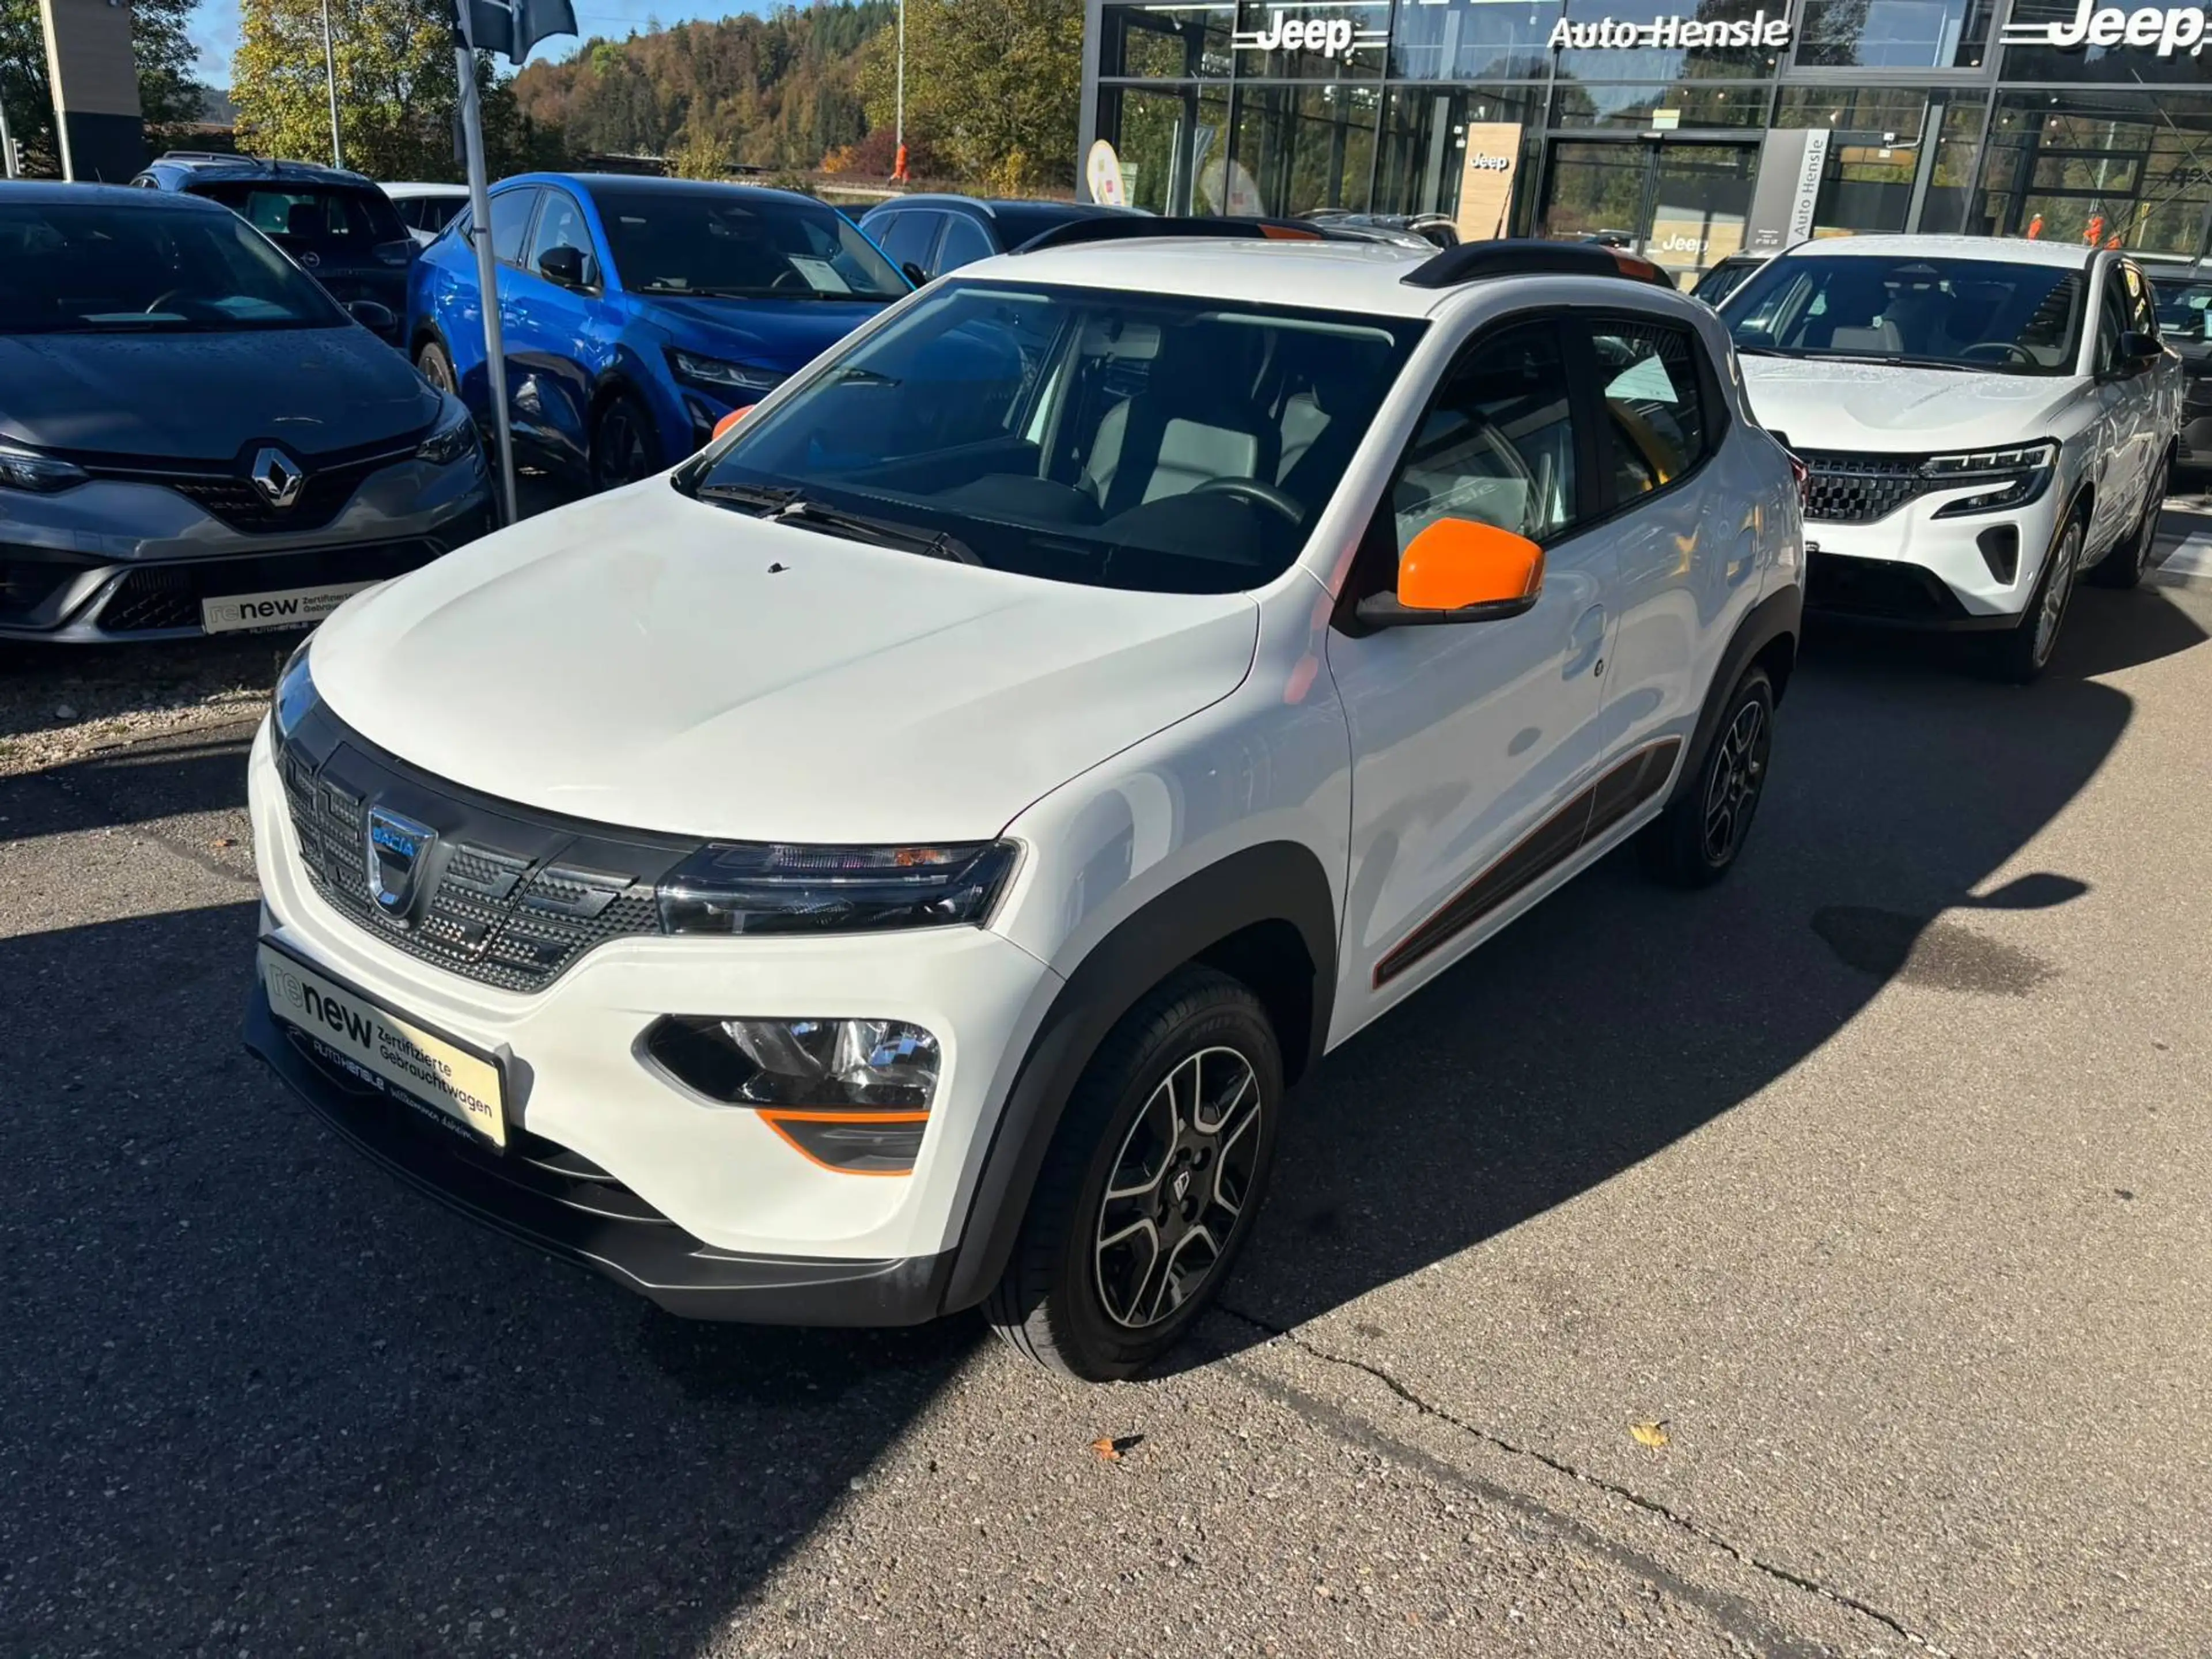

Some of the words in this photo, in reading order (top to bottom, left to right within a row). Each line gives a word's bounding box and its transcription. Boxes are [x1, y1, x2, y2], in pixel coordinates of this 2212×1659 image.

[1256, 10, 1352, 58] Jeep
[1546, 16, 1639, 48] Auto
[1651, 10, 1791, 48] Hensle
[2047, 0, 2205, 56] Jeep
[1470, 151, 1509, 172] Jeep
[1802, 139, 1824, 194] Hensle
[1794, 199, 1811, 237] Auto
[209, 599, 298, 623] renew
[372, 826, 414, 857] DACIA
[270, 964, 372, 1049] renew
[377, 1025, 452, 1077] Zertifizierte
[380, 1046, 493, 1118] Gebrauchtwagen
